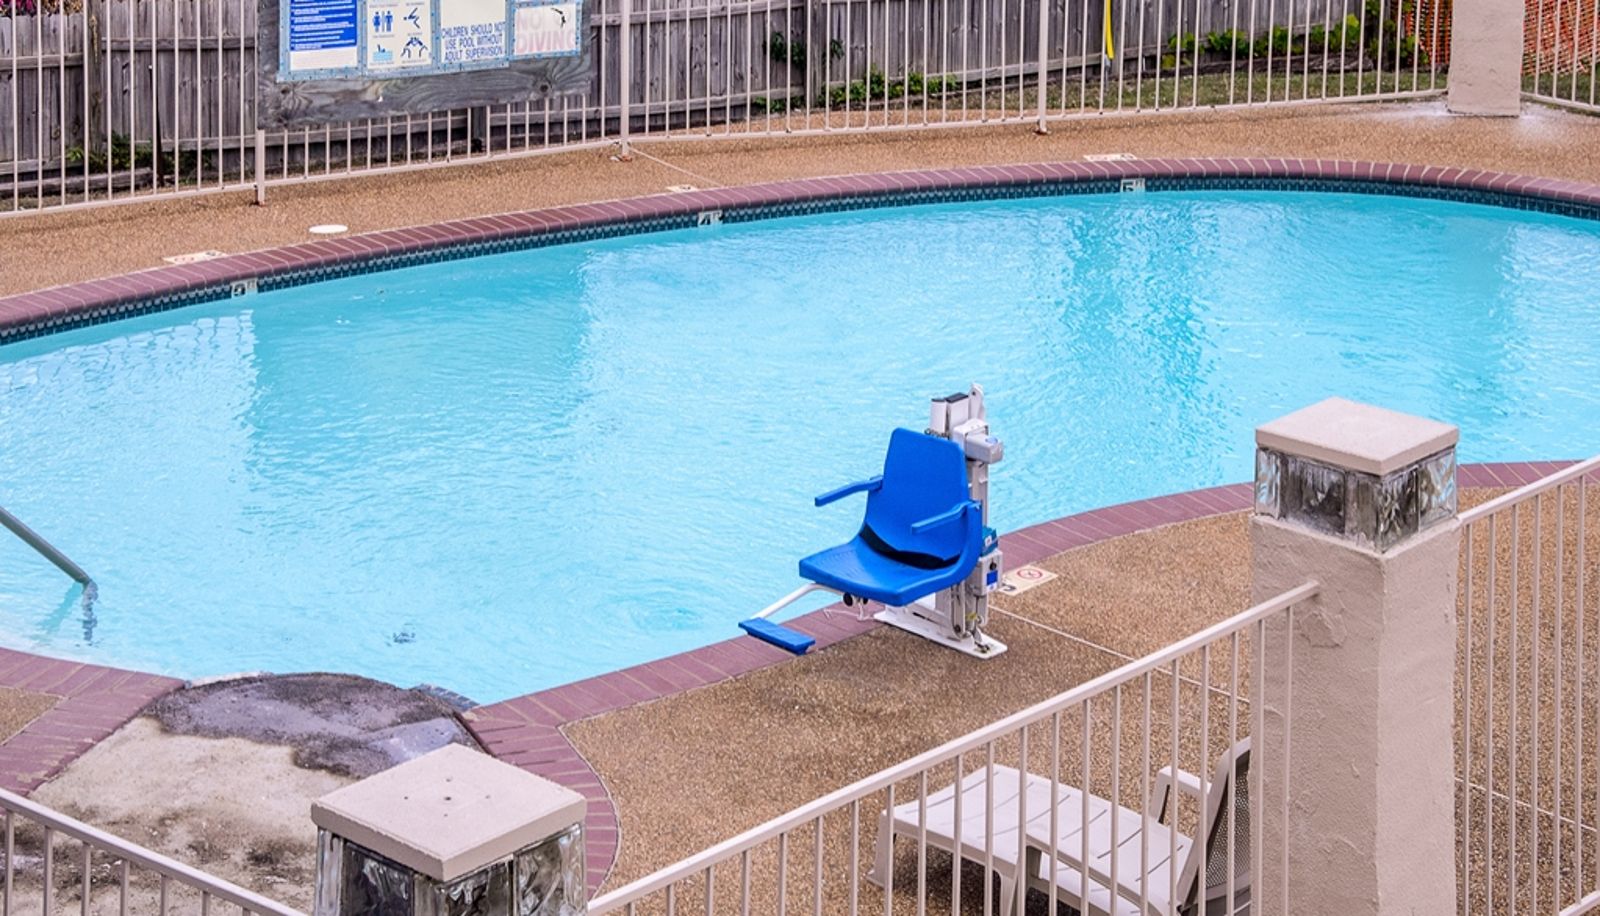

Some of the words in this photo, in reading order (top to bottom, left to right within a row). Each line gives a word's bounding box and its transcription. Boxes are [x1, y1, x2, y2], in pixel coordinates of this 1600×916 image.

[441, 26, 468, 38] CHILDREN
[470, 23, 493, 34] SHOULD
[494, 21, 506, 32] NOT
[444, 38, 457, 48] USE
[459, 36, 475, 48] POOL
[477, 33, 503, 45] WITHOUT
[516, 30, 577, 53] DIVING
[445, 49, 462, 61] ADULT
[465, 46, 503, 59] SUPERVISION
